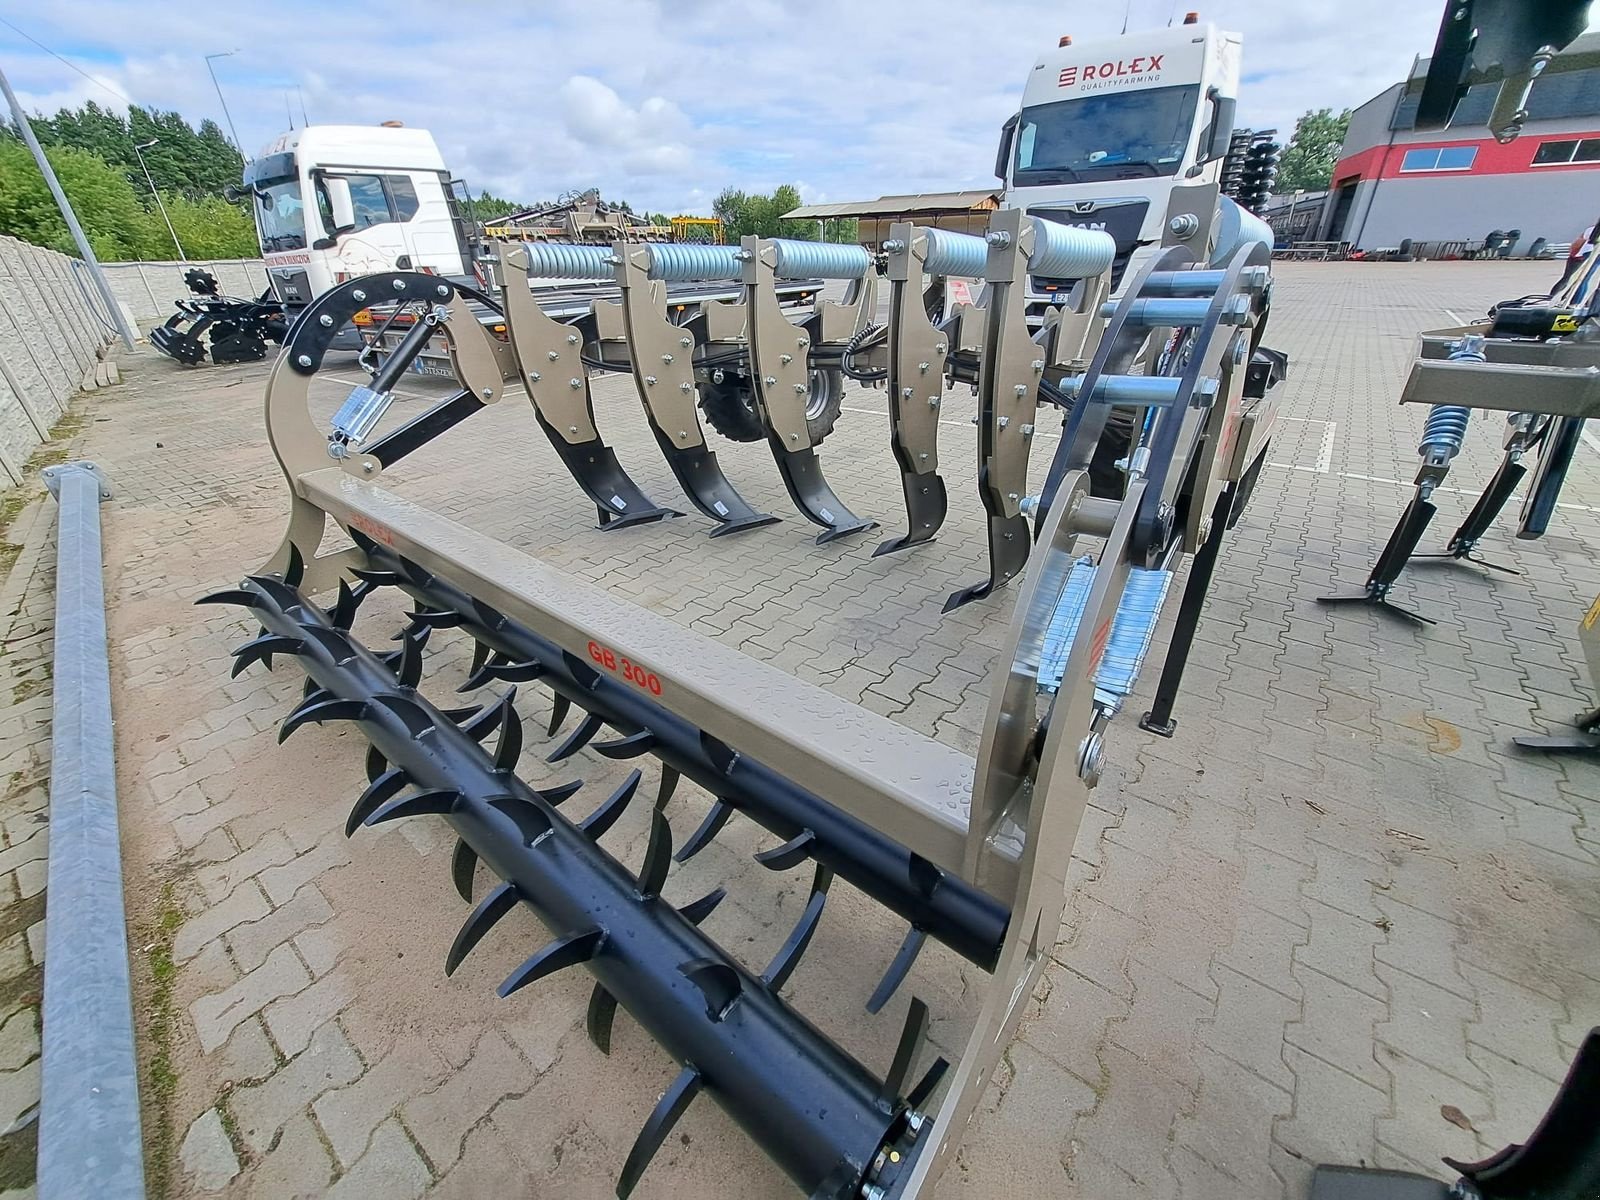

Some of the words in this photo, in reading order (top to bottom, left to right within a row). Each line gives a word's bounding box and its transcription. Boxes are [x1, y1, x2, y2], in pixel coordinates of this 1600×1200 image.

[1082, 55, 1165, 81] ROLEX
[1080, 74, 1162, 92] QUALITYFARMING
[587, 640, 617, 671] GB
[620, 657, 662, 696] 300
